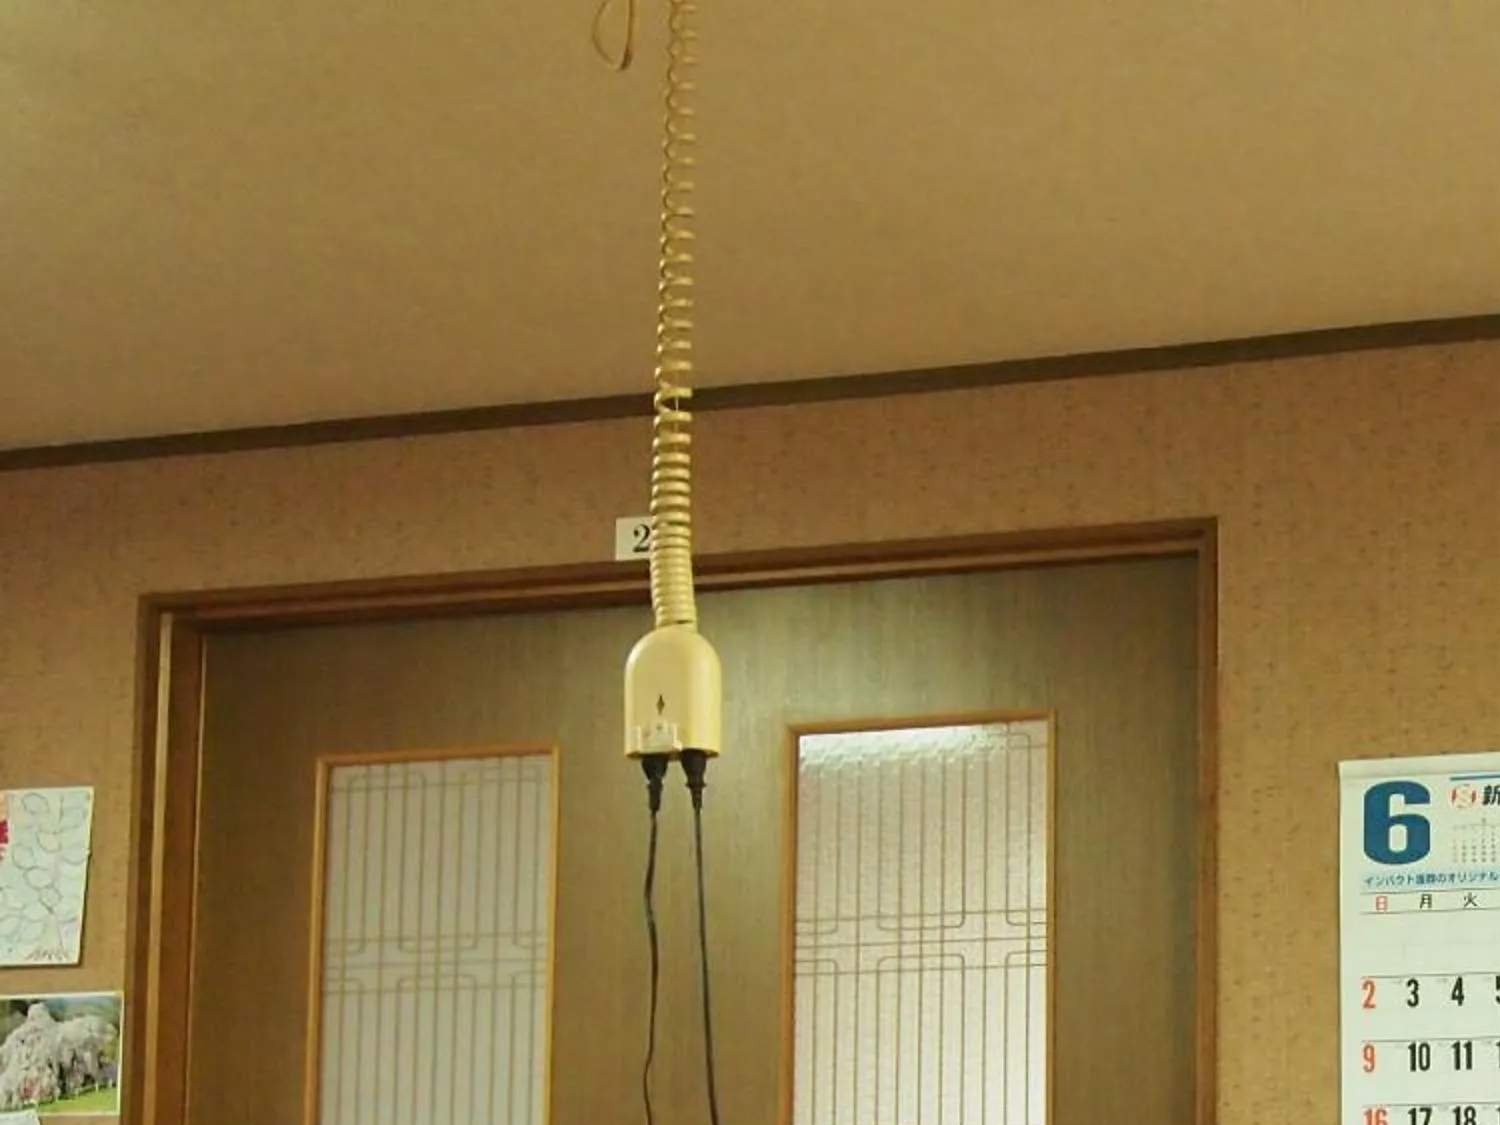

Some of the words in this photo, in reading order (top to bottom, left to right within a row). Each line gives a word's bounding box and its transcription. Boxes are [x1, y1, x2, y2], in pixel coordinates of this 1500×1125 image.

[632, 523, 651, 553] 2
[1363, 780, 1432, 865] 6
[1375, 896, 1388, 910] 日
[1419, 894, 1433, 909] 月
[1463, 892, 1478, 907] 火
[1363, 980, 1375, 1008] 2
[1406, 978, 1419, 1008] 3
[1451, 976, 1464, 1006] 4
[1363, 1044, 1375, 1072] 9
[1408, 1042, 1432, 1072] 10
[1452, 1040, 1472, 1070] 11
